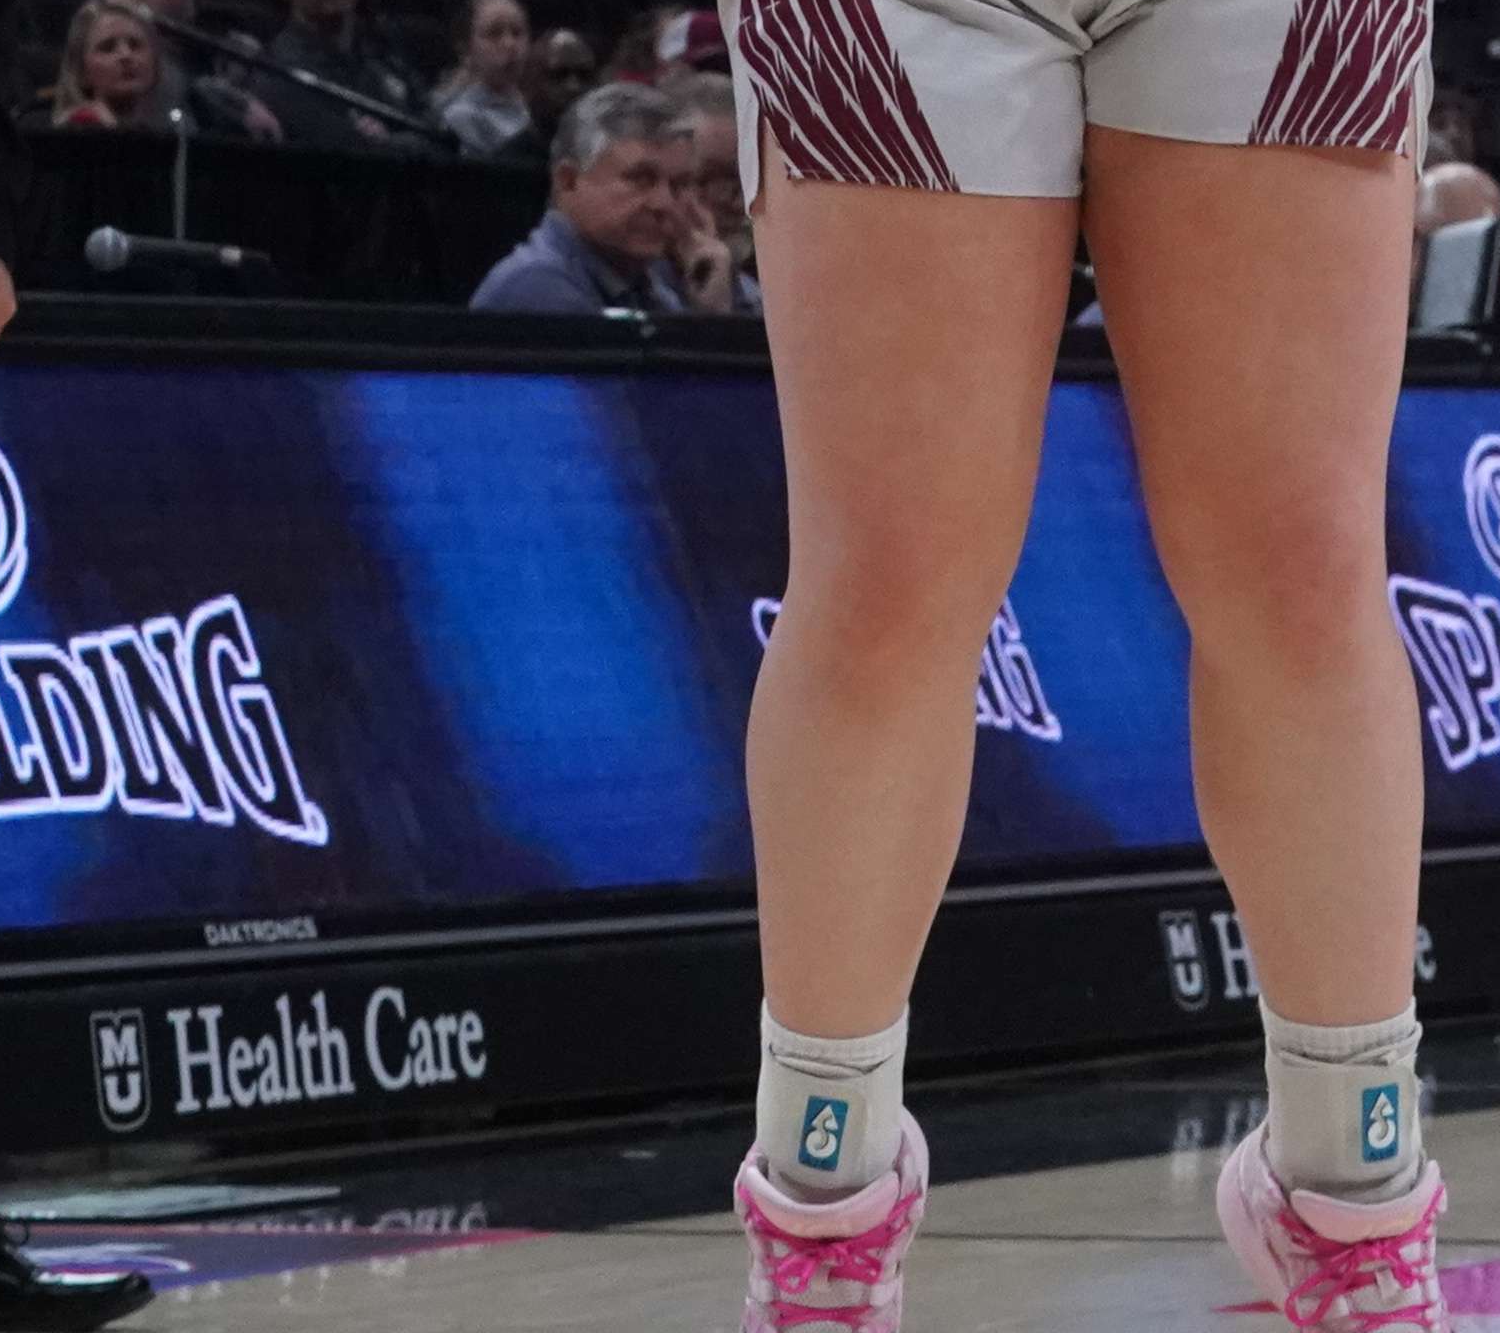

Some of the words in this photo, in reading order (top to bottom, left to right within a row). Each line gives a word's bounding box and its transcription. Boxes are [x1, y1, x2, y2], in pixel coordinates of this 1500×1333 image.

[203, 915, 319, 947] DAKTRONICS
[165, 988, 357, 1116] Health
[363, 984, 488, 1093] Care
